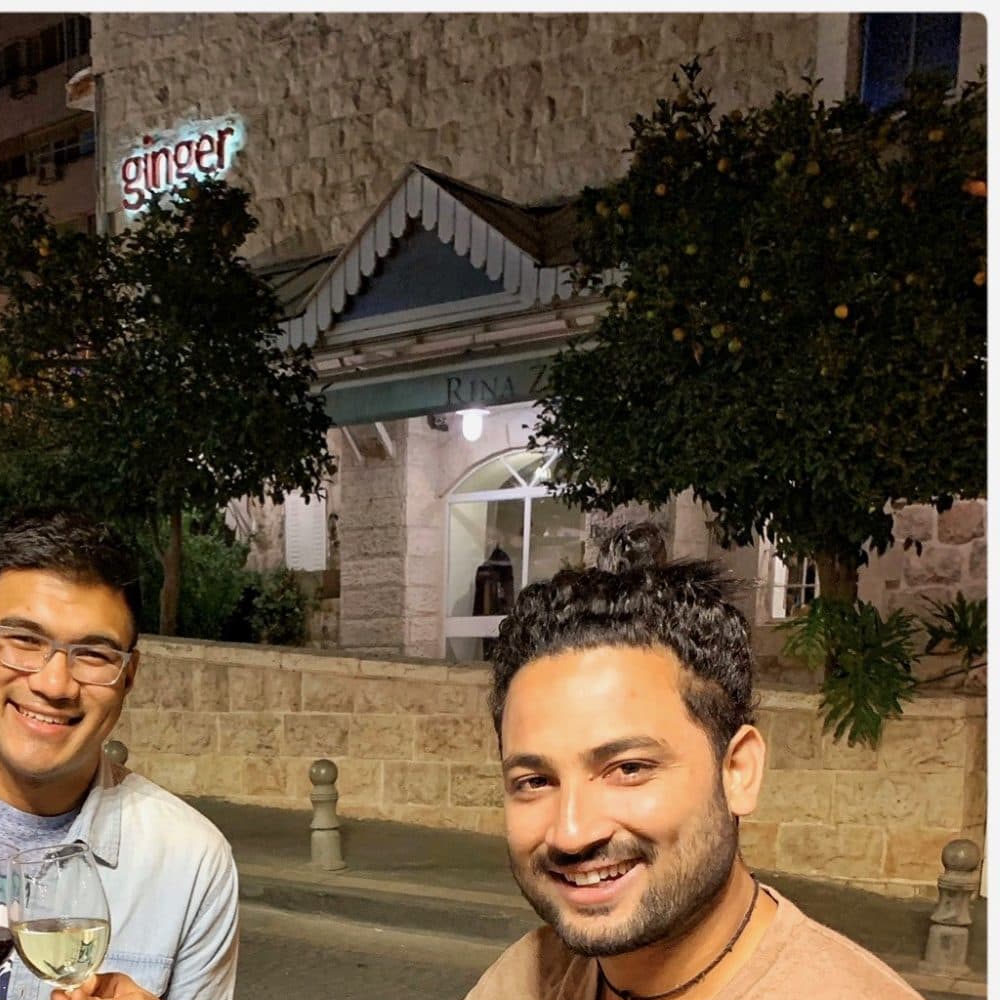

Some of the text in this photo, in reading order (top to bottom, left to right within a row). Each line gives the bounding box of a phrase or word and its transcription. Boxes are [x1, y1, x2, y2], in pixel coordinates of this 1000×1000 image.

[122, 126, 234, 210] ginger
[447, 363, 553, 408] RINA Z
